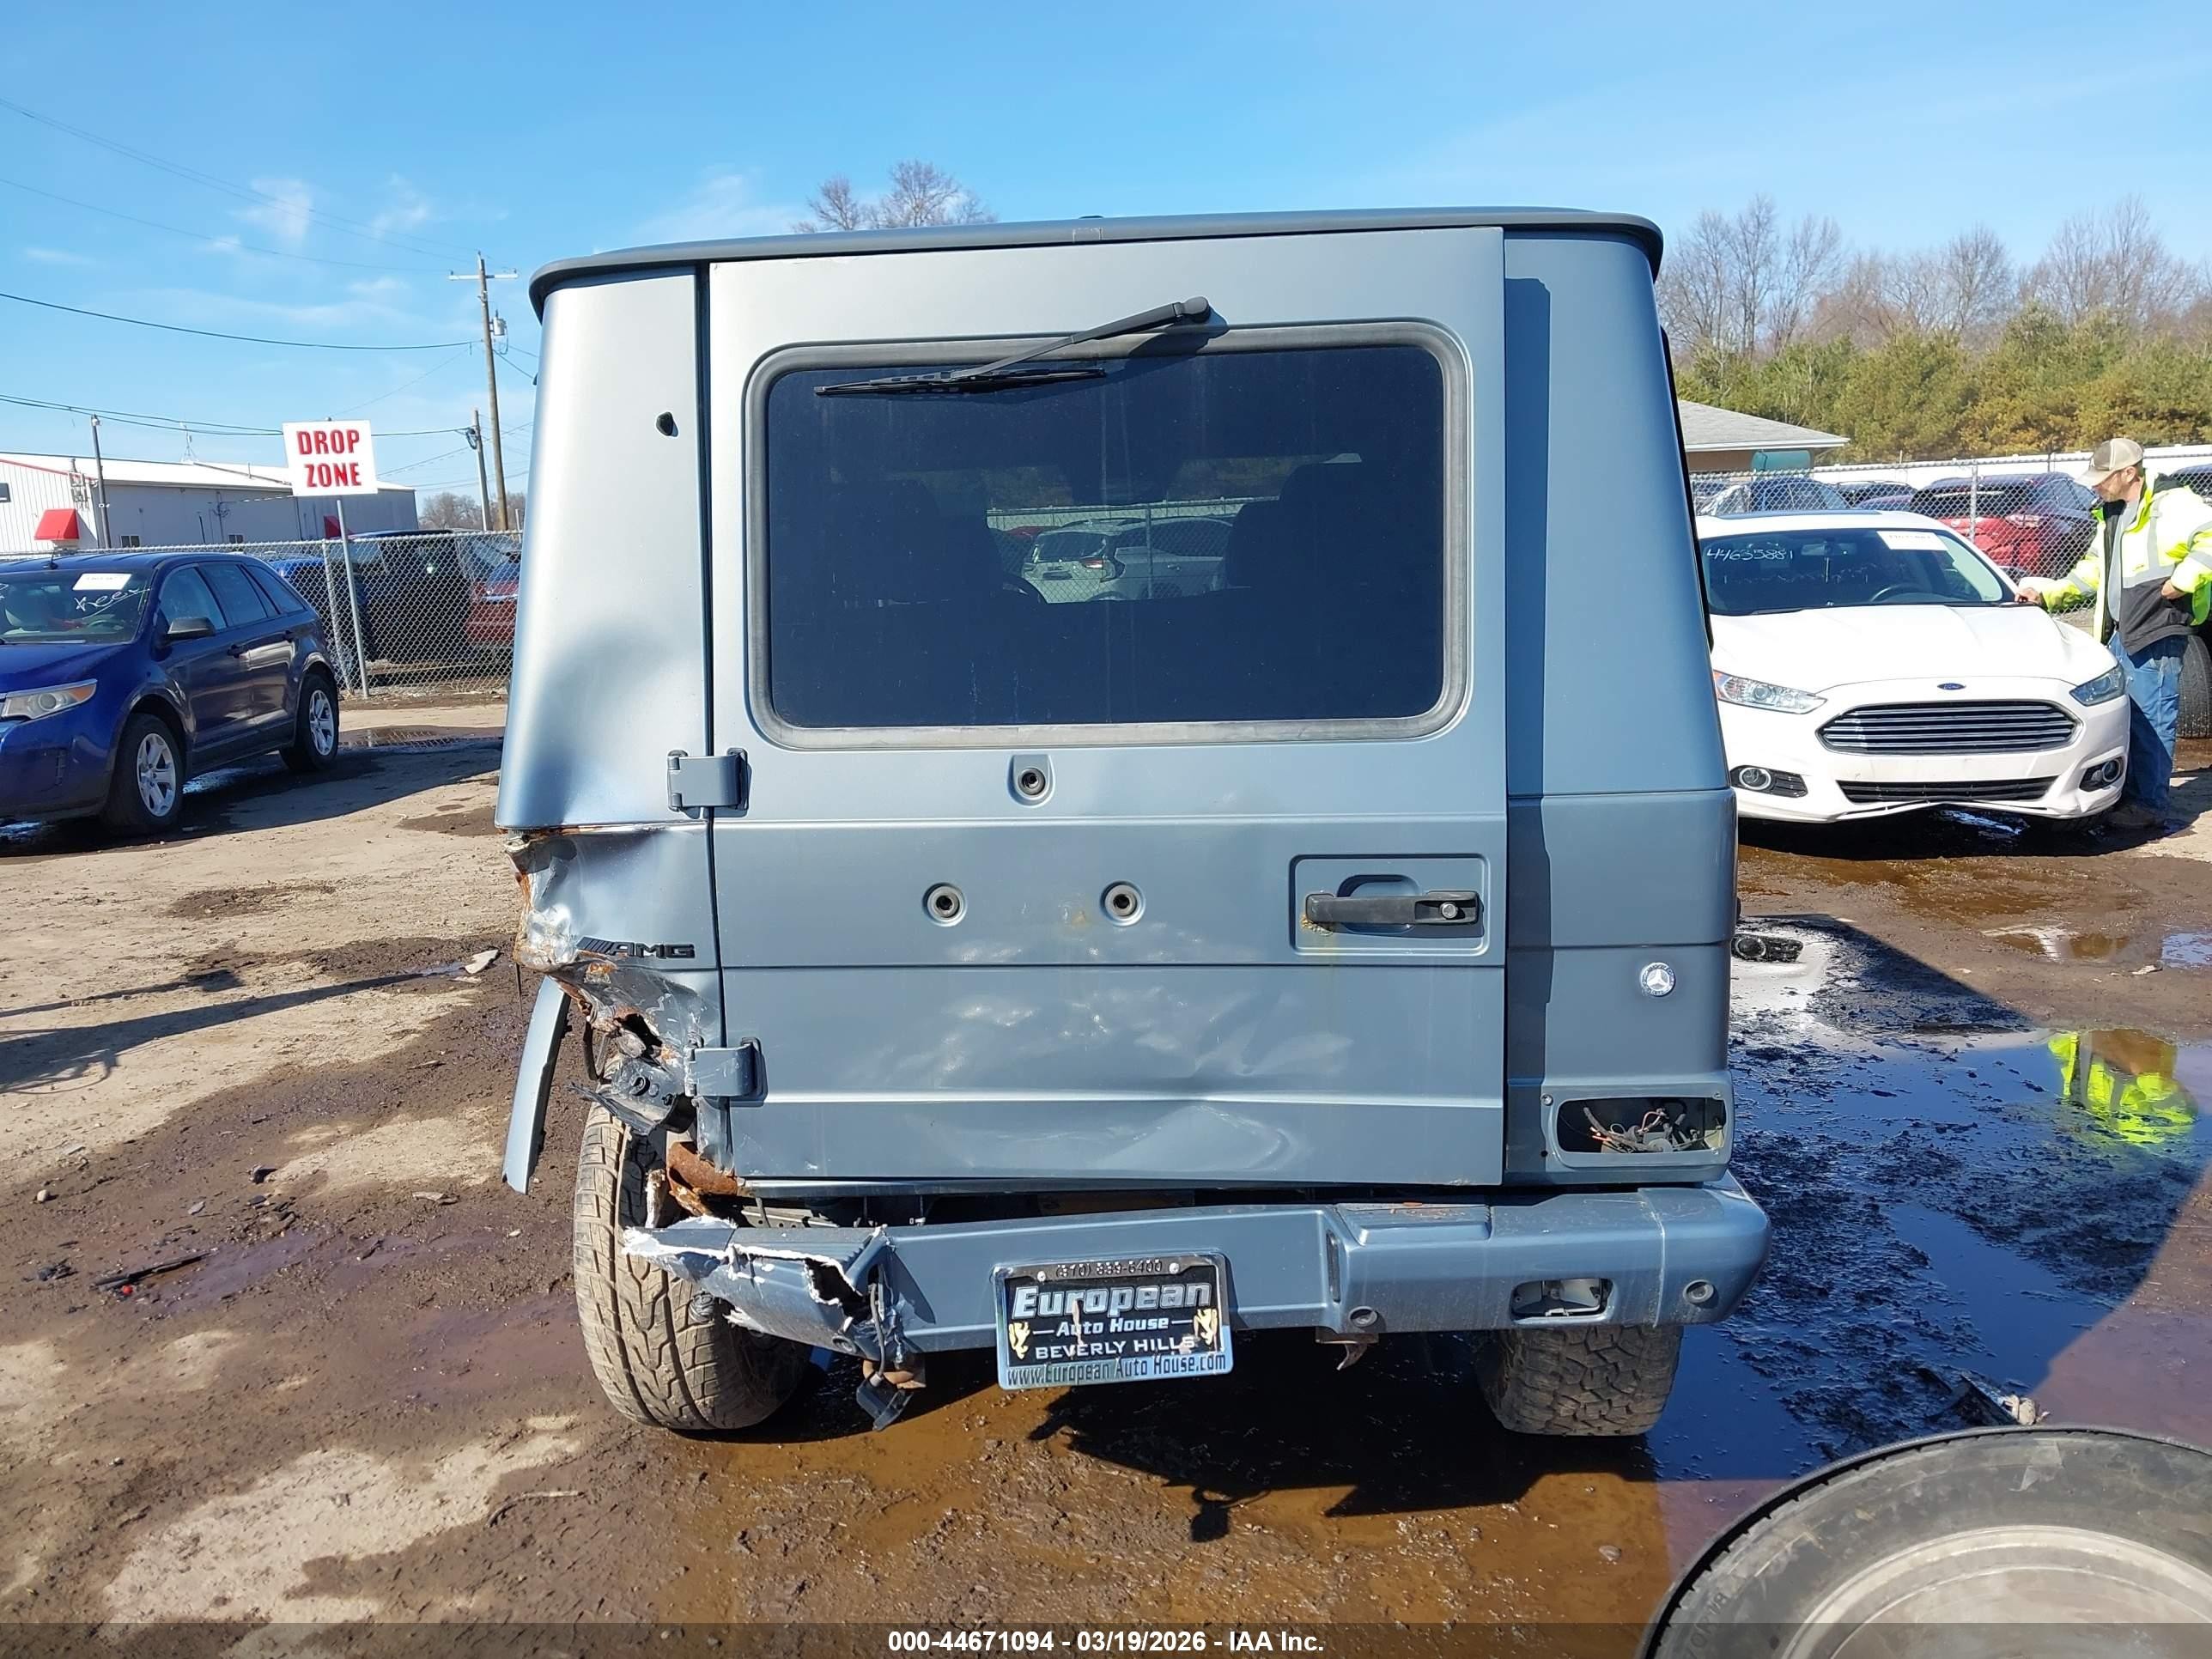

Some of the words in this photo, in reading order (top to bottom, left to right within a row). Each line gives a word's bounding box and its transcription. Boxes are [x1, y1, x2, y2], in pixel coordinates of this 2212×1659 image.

[296, 429, 360, 455] DROP
[304, 462, 362, 488] ZONE
[608, 942, 696, 959] AMG
[1012, 1283, 1212, 1318] European
[1056, 1321, 1103, 1337] Auto
[1109, 1317, 1169, 1334] House
[1035, 1340, 1127, 1360] BEVERLY
[1133, 1335, 1196, 1353] HILLS
[1006, 1361, 1111, 1387] www.European
[1116, 1358, 1148, 1377] Auto
[1153, 1352, 1227, 1375] House.com
